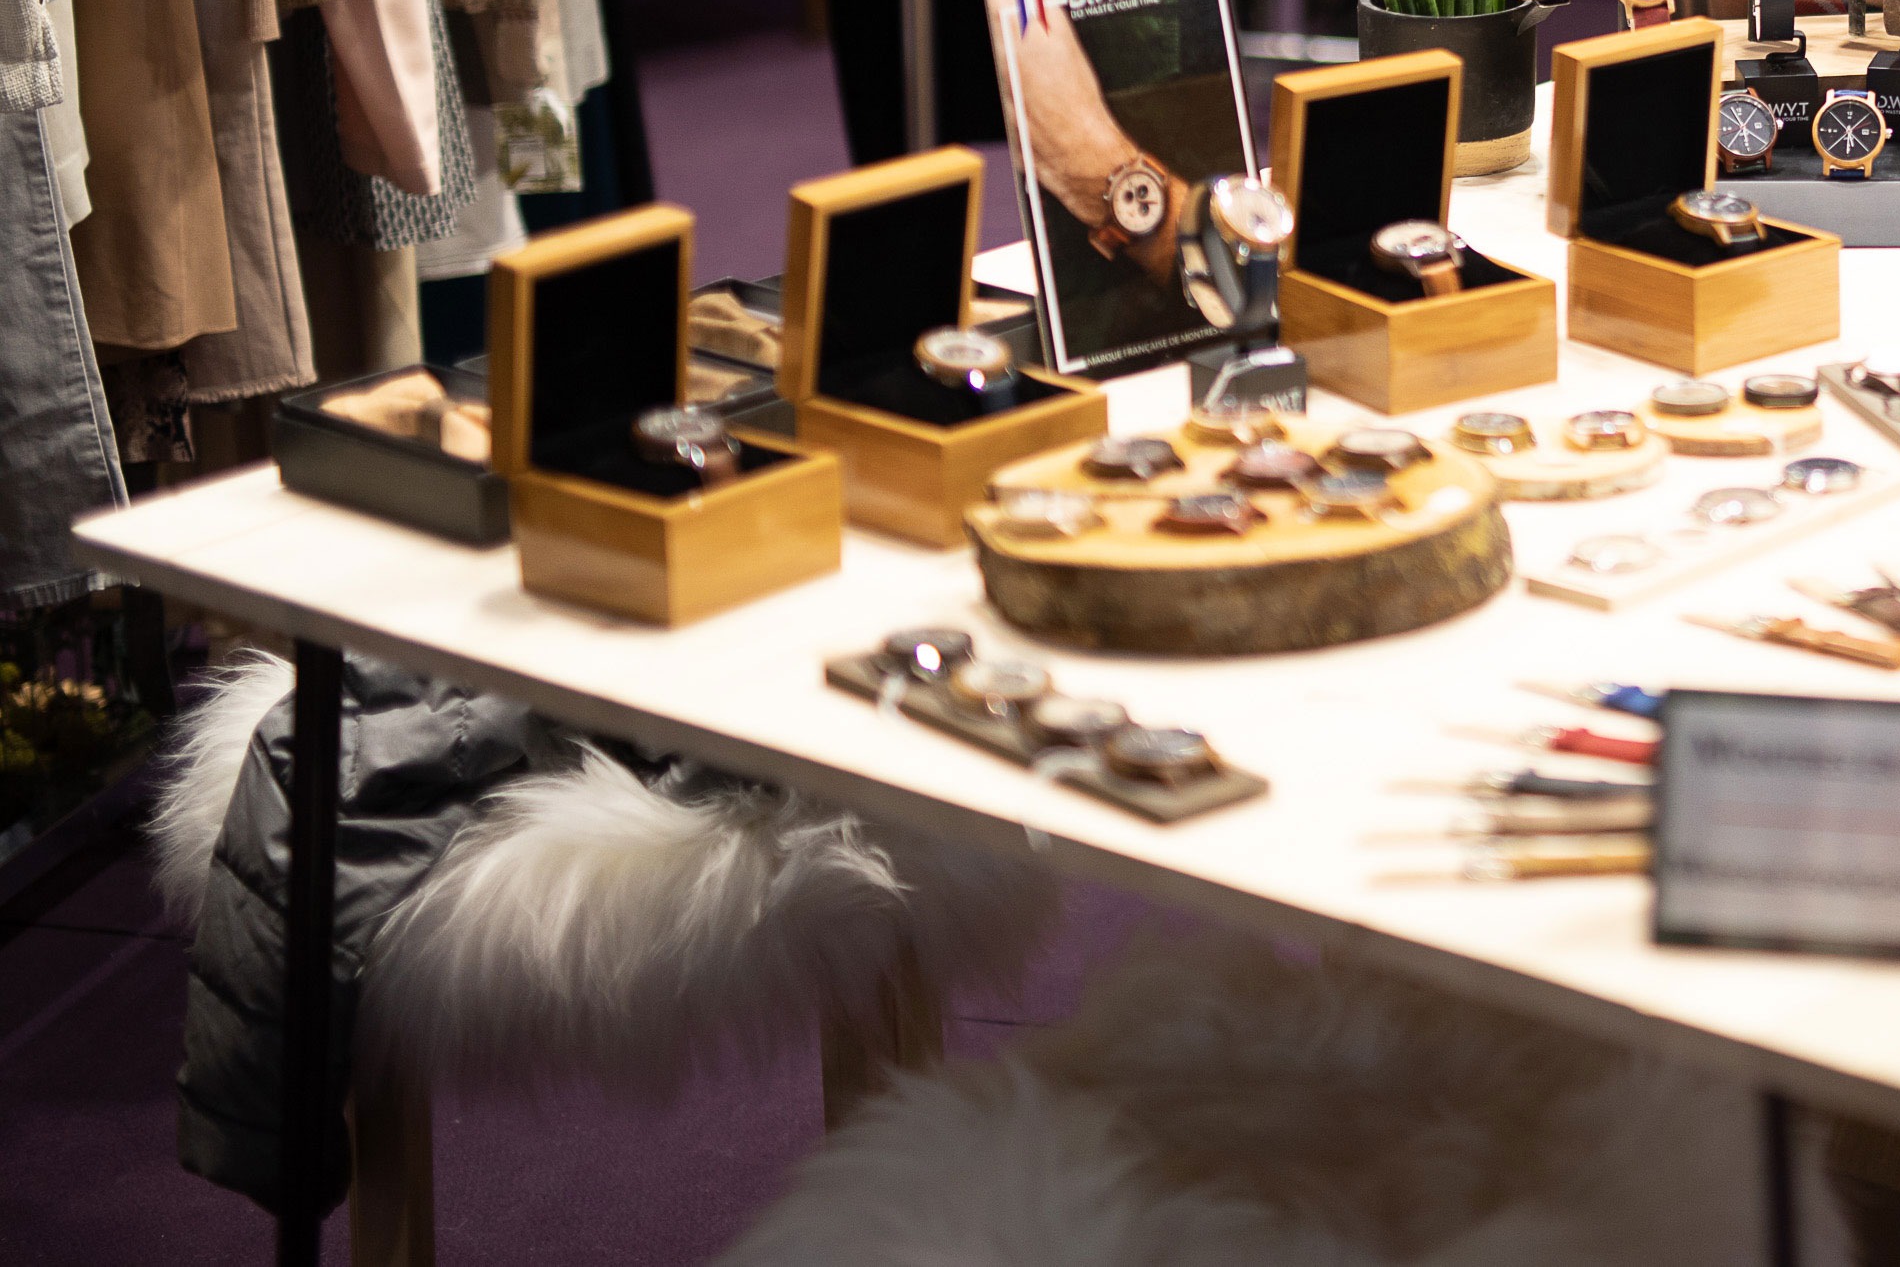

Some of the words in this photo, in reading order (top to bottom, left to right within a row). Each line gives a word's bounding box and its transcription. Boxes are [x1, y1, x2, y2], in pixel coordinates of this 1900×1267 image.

[1070, 9, 1086, 21] DO
[1085, 2, 1114, 15] WASTE
[1768, 102, 1809, 116] W.Y.T
